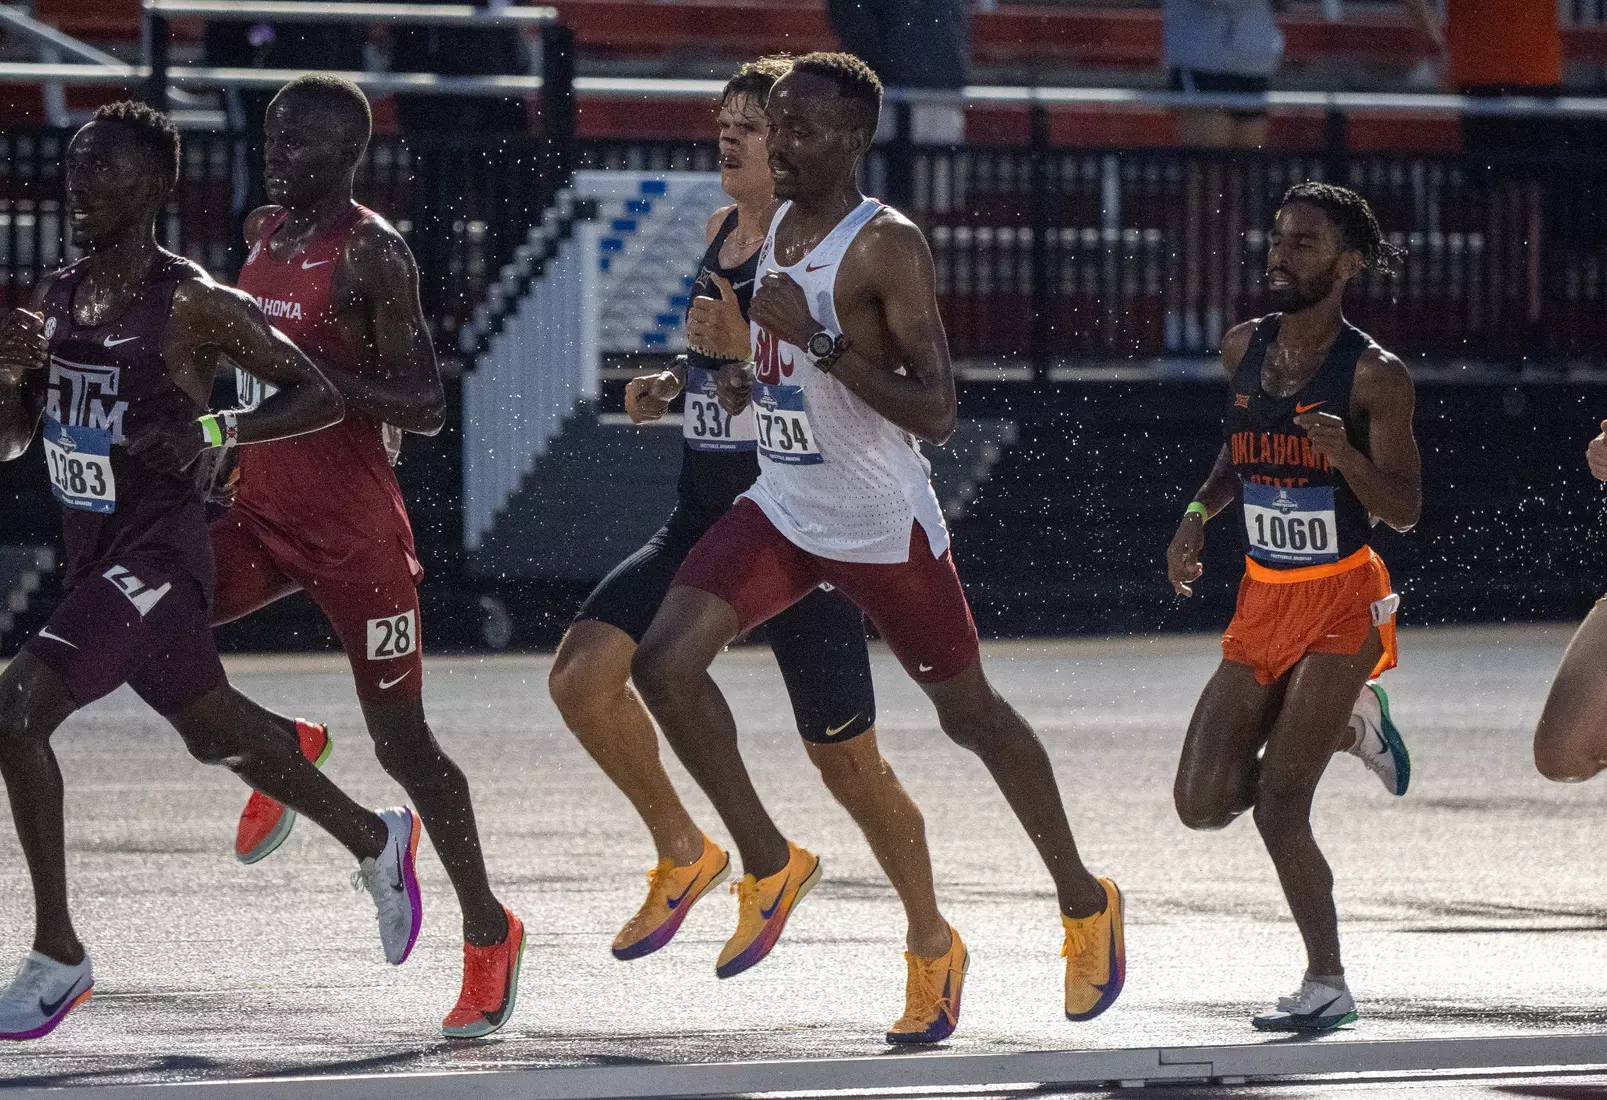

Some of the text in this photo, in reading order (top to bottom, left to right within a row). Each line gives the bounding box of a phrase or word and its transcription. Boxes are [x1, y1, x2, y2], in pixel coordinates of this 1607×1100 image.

[756, 411, 808, 451] 1734
[50, 449, 107, 497] 1383
[1254, 513, 1328, 551] 1060
[375, 615, 410, 657] 28
